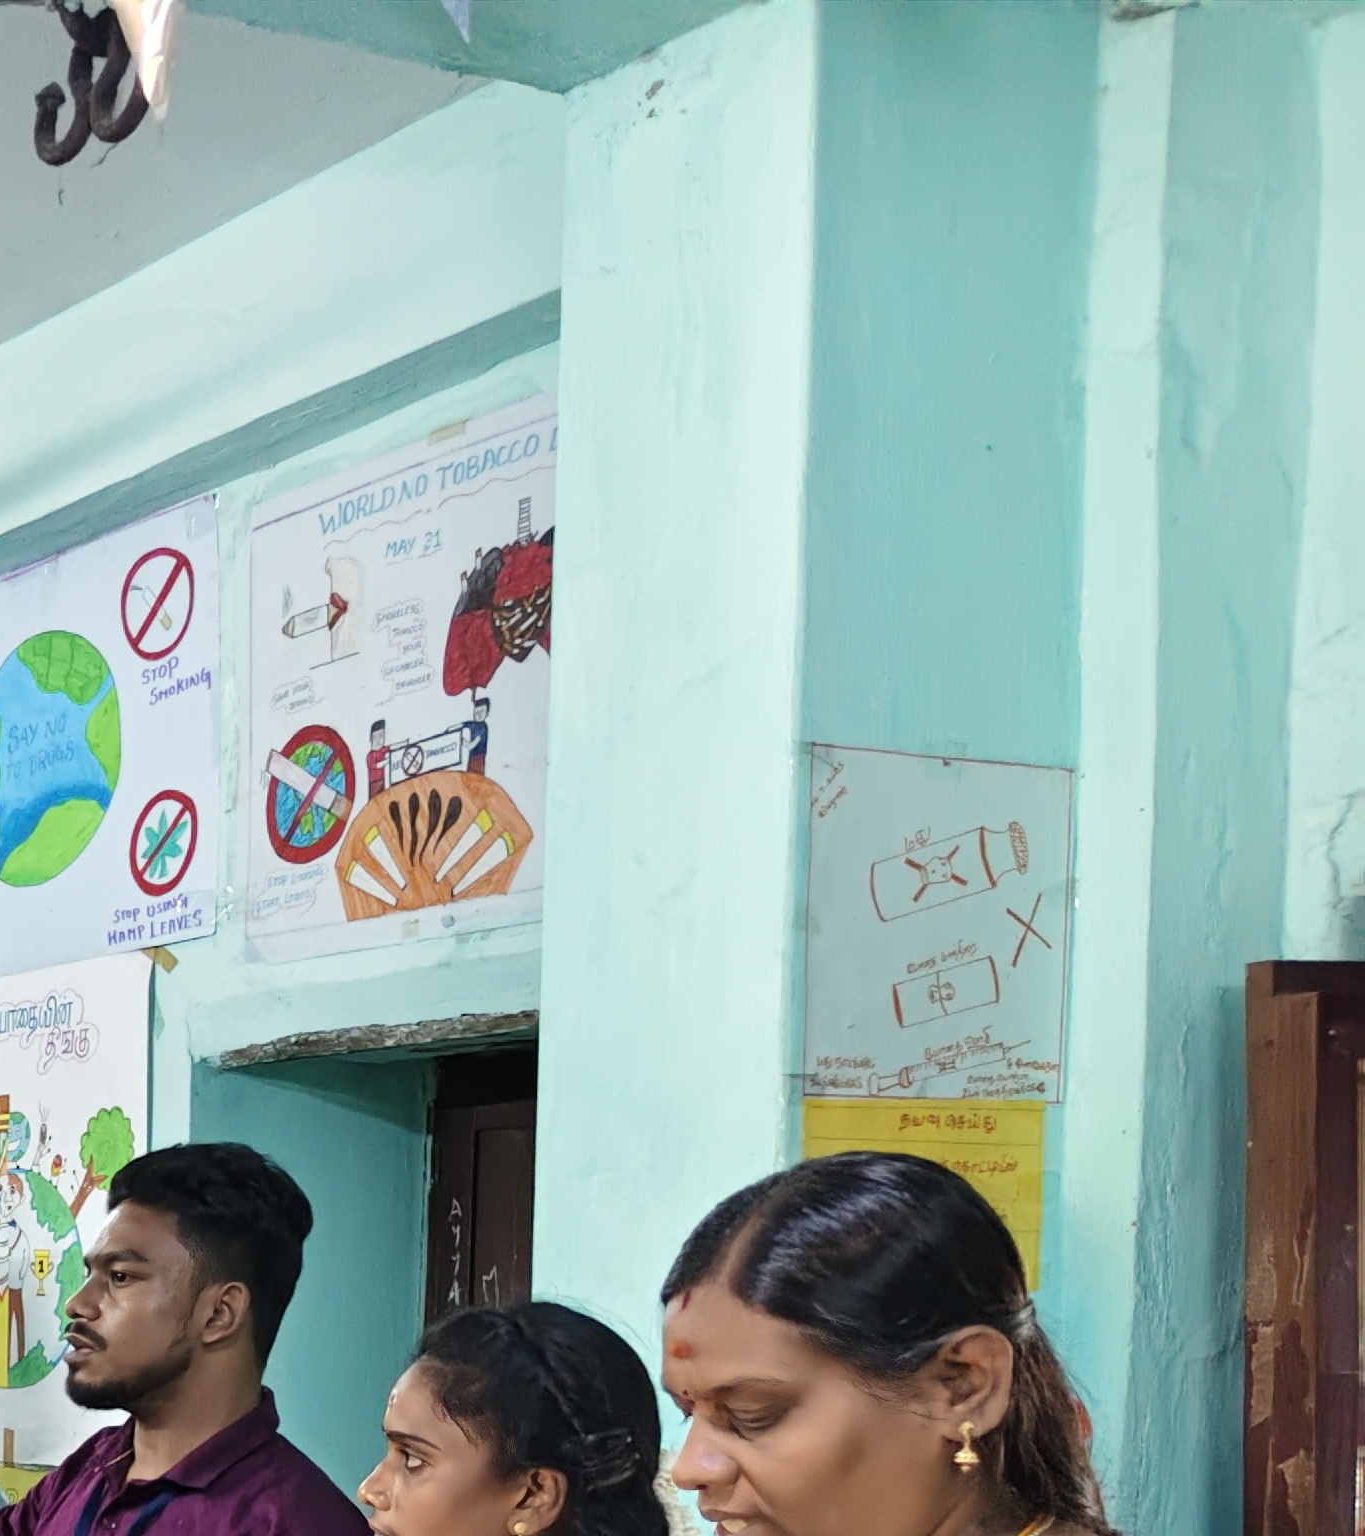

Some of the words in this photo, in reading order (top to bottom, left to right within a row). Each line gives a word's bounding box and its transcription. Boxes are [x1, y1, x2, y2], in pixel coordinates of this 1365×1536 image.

[318, 486, 395, 536] WORLD
[397, 473, 428, 505] NO
[437, 434, 540, 491] TOBACCO
[385, 537, 416, 559] MAY
[141, 656, 180, 685] STOP
[149, 668, 212, 705] SMOKING
[8, 722, 39, 752] SAY
[45, 713, 67, 739] NO
[29, 743, 75, 776] DRUGS
[113, 906, 141, 924] STOP
